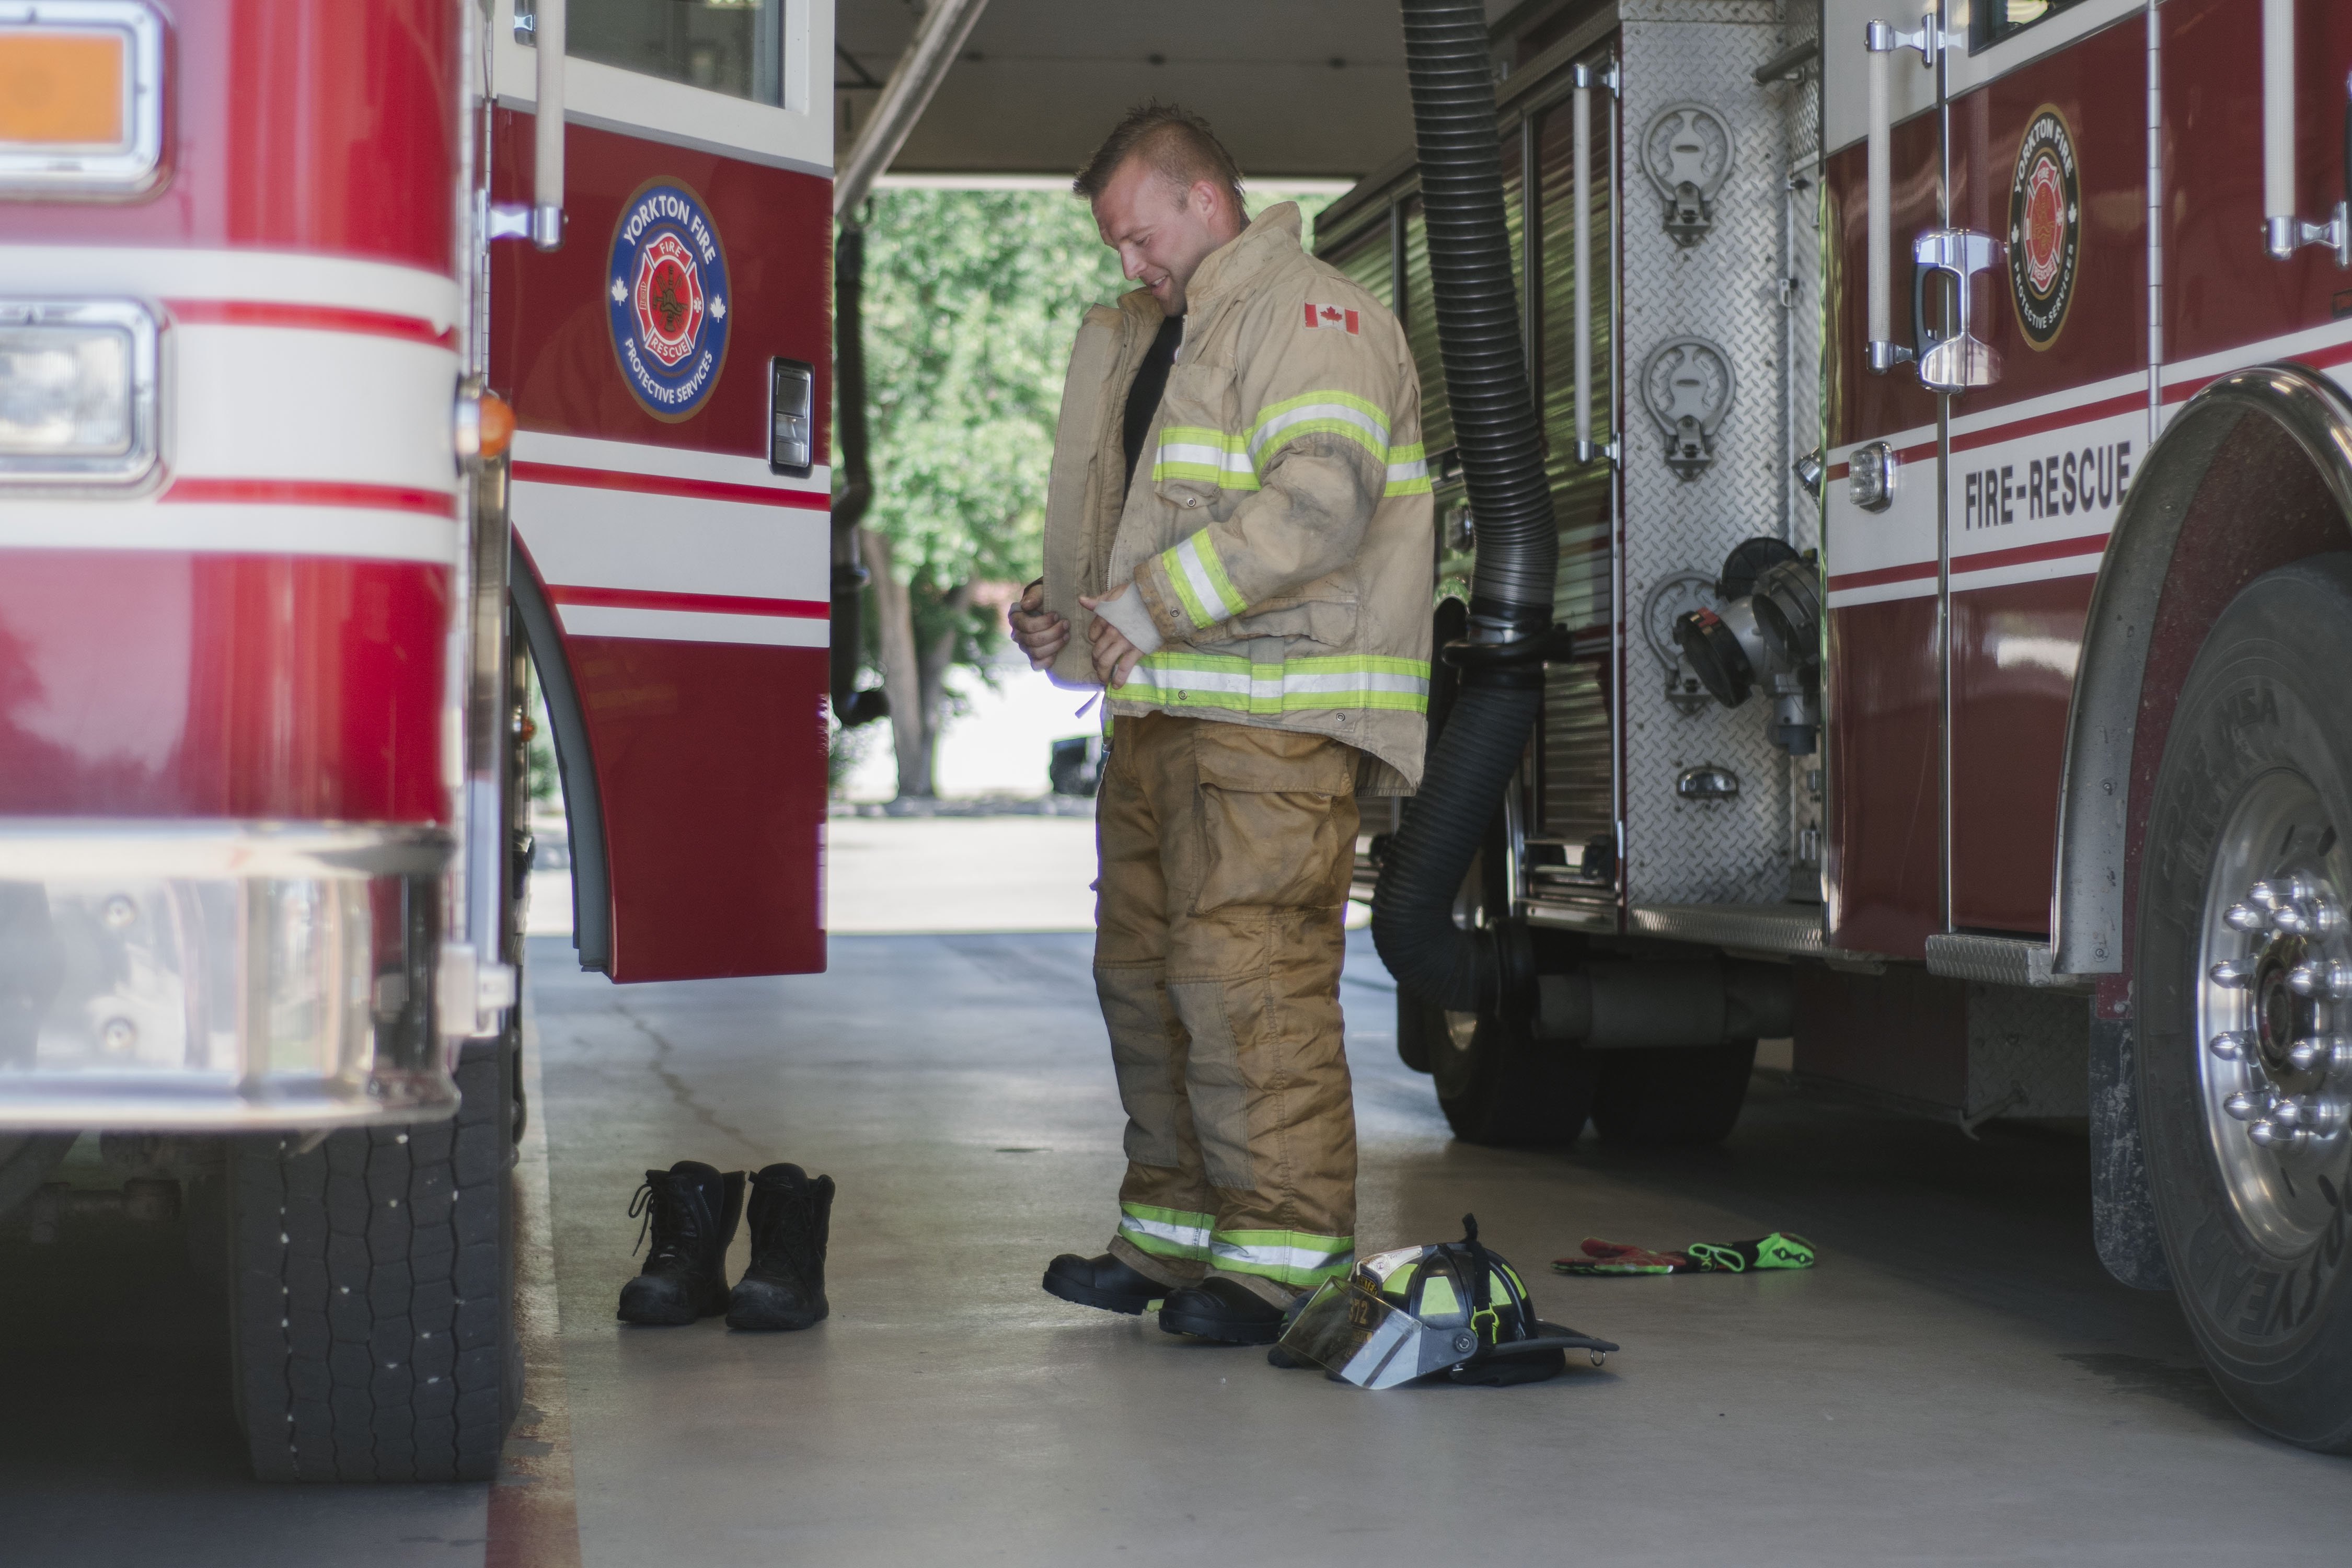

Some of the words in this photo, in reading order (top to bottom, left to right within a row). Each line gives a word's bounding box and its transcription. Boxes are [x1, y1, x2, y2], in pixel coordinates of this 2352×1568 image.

[2014, 118, 2054, 194] YORKTON
[2054, 126, 2073, 178] FIRE
[2037, 166, 2049, 179] FIRE
[624, 195, 690, 247] YORKTON
[691, 215, 716, 265] FIRE
[659, 241, 683, 258] FIRE
[2014, 261, 2047, 330] PROTECTIVE
[2048, 243, 2073, 324] SERVICES
[2034, 263, 2054, 281] RESCUE
[625, 338, 675, 404] PROTECTIVE
[677, 350, 713, 403] SERVICES
[650, 339, 689, 358] RESCUE
[1965, 440, 2131, 531] FIRE-RESCUE
